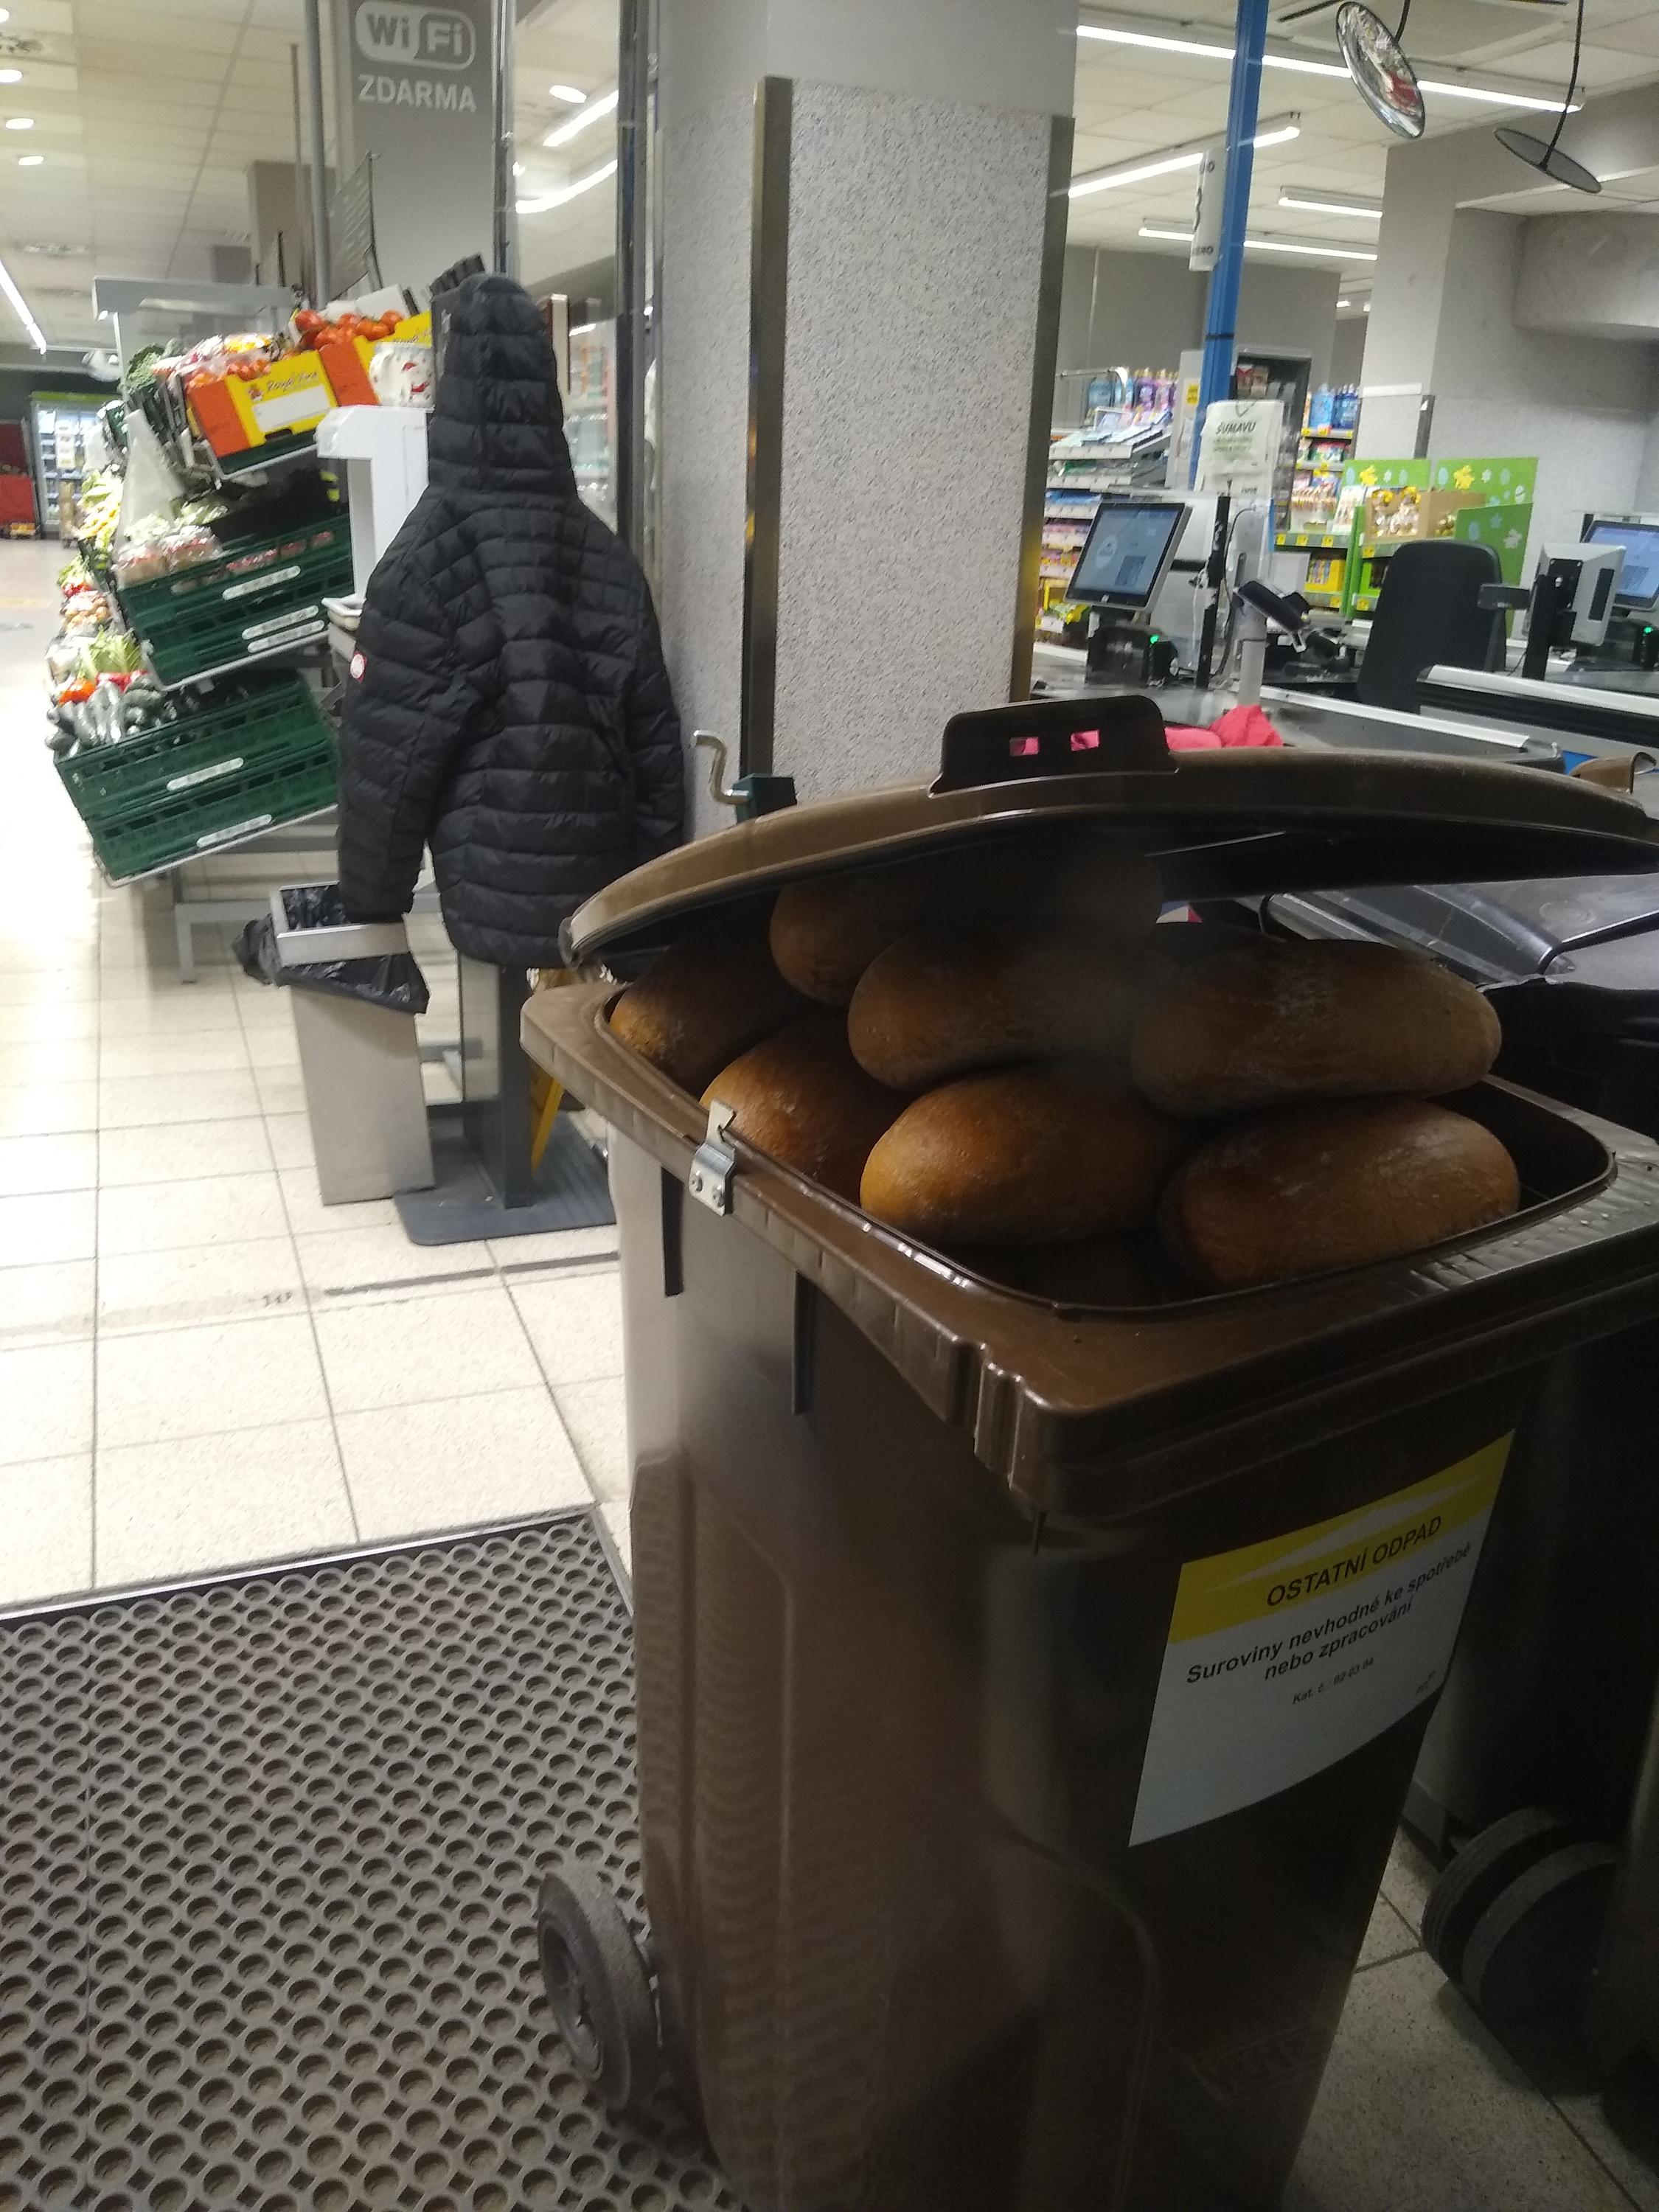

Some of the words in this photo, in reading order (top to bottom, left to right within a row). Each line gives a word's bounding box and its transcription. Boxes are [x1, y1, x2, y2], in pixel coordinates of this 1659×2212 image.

[358, 73, 477, 112] ZDARMA
[1266, 1547, 1368, 1607] OSTATNÍ
[1371, 1516, 1441, 1565] ODPAD
[1186, 1641, 1283, 1684] Suroviny
[1289, 1596, 1380, 1649] nevhodné
[1385, 1586, 1403, 1605] ke
[1407, 1540, 1472, 1593] spotřebě
[1264, 1651, 1313, 1680] nebo
[1318, 1596, 1414, 1660] zpracování
